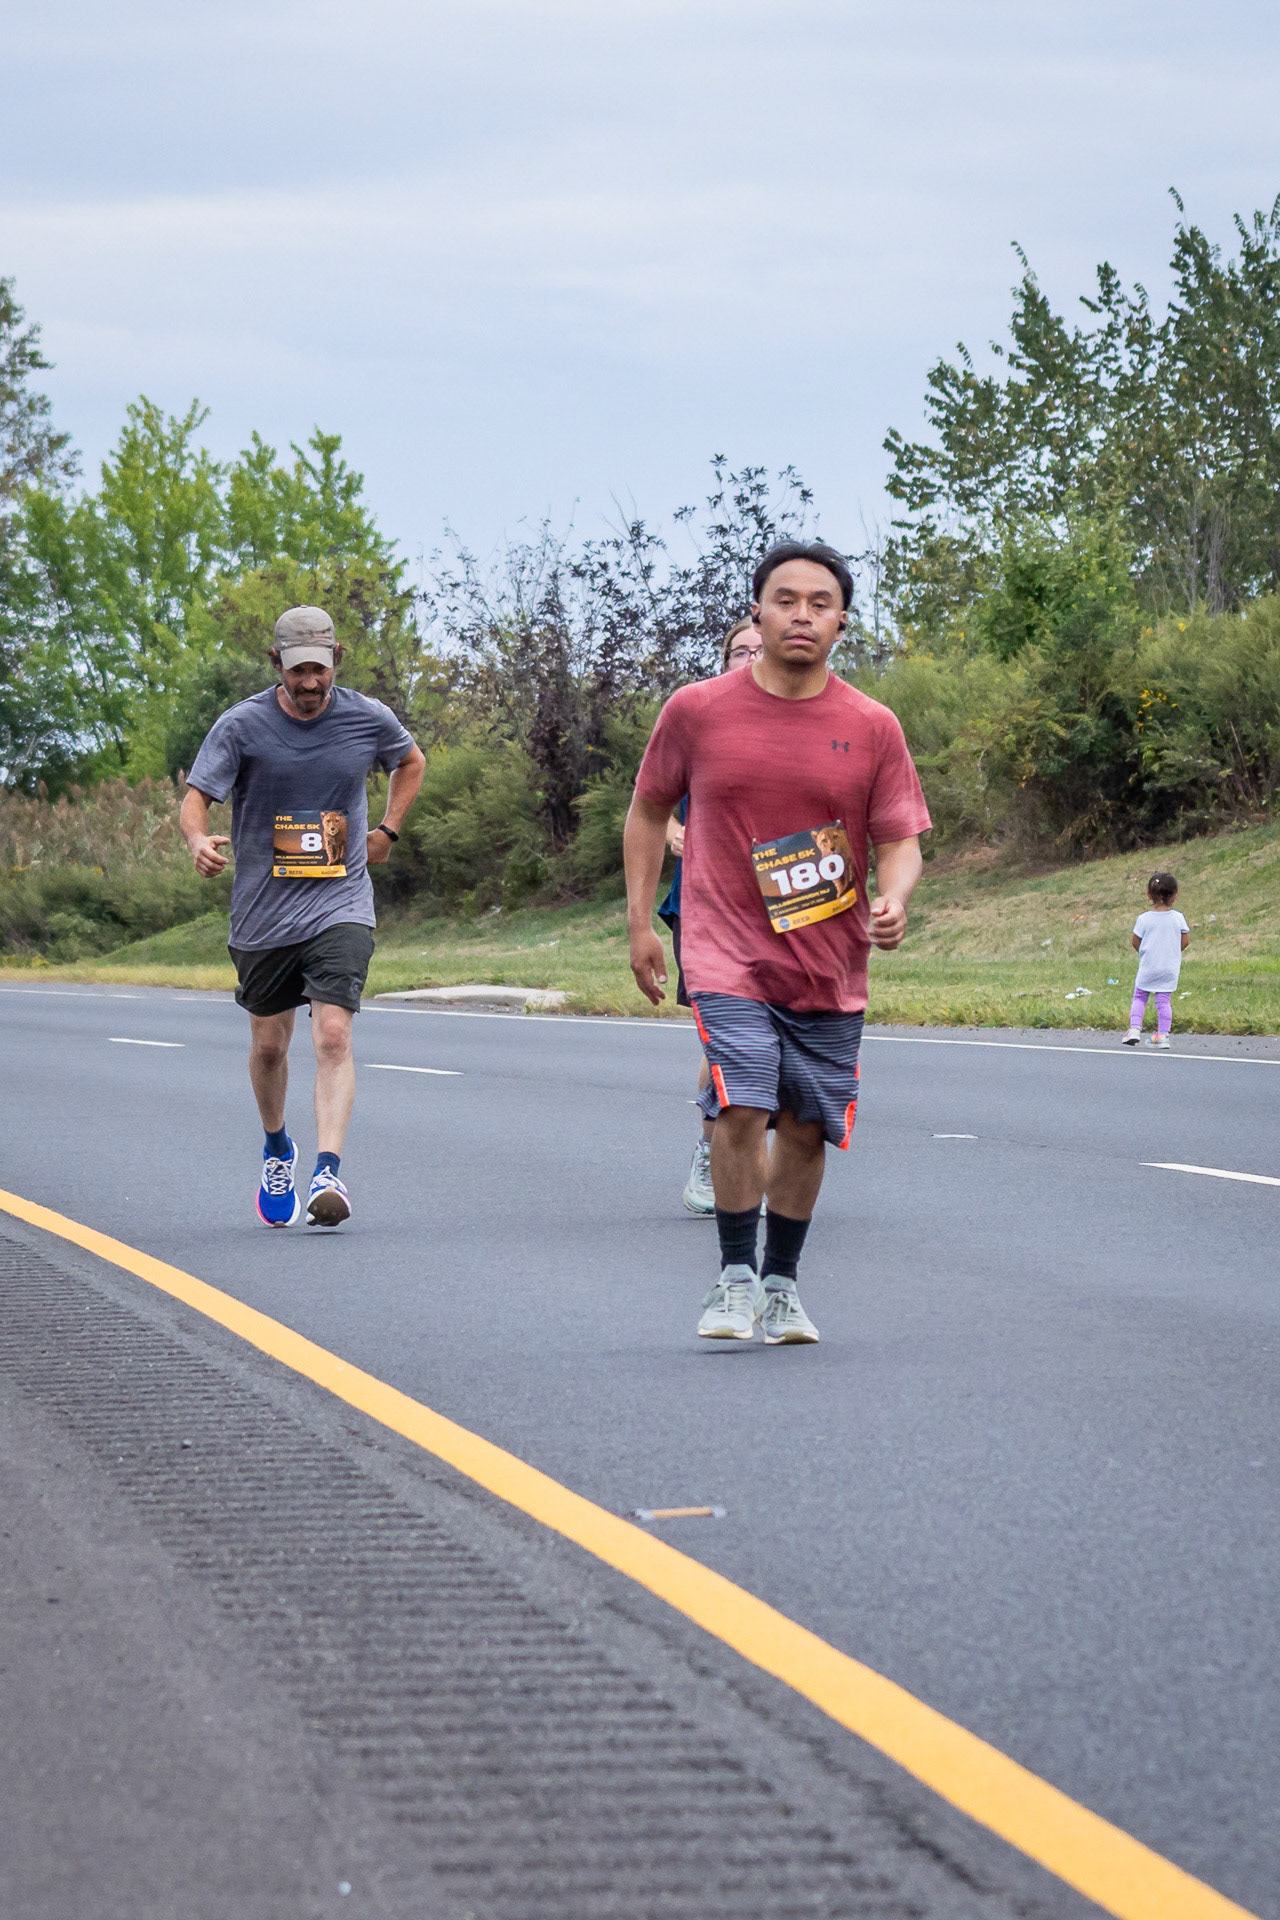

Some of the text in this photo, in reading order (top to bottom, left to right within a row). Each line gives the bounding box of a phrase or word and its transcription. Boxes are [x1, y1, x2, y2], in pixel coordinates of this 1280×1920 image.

[301, 833, 323, 852] 8
[752, 848, 778, 861] THE
[756, 848, 816, 872] CHASE 5K
[770, 854, 845, 896] 180
